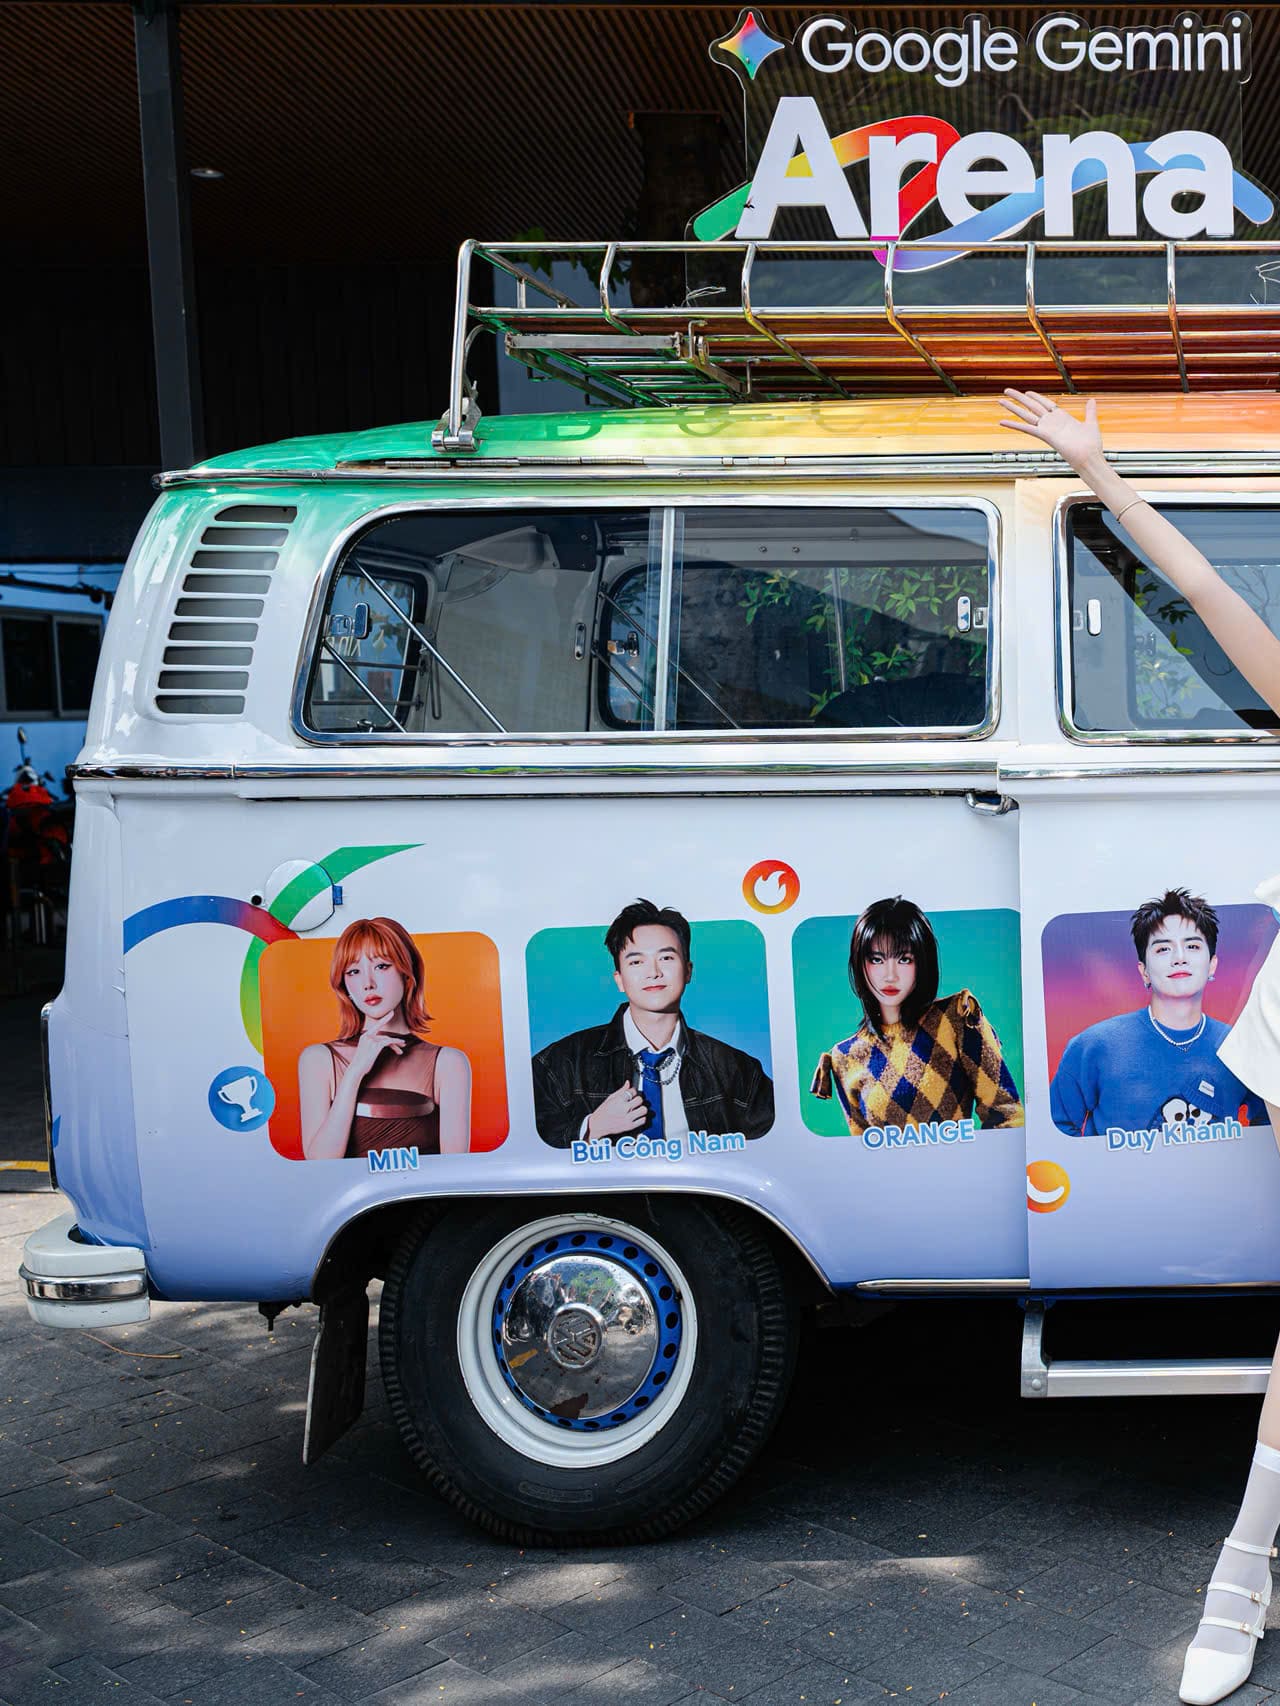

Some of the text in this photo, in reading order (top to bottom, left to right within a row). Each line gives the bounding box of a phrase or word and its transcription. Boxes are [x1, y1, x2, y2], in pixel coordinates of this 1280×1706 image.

[801, 17, 1242, 88] Google Gemini
[735, 96, 1235, 240] Arena
[573, 1131, 745, 1162] Bùi Công Nam
[864, 1120, 975, 1148] ORANGE
[1108, 1117, 1243, 1152] Duy Khánh
[369, 1147, 418, 1172] MIN
